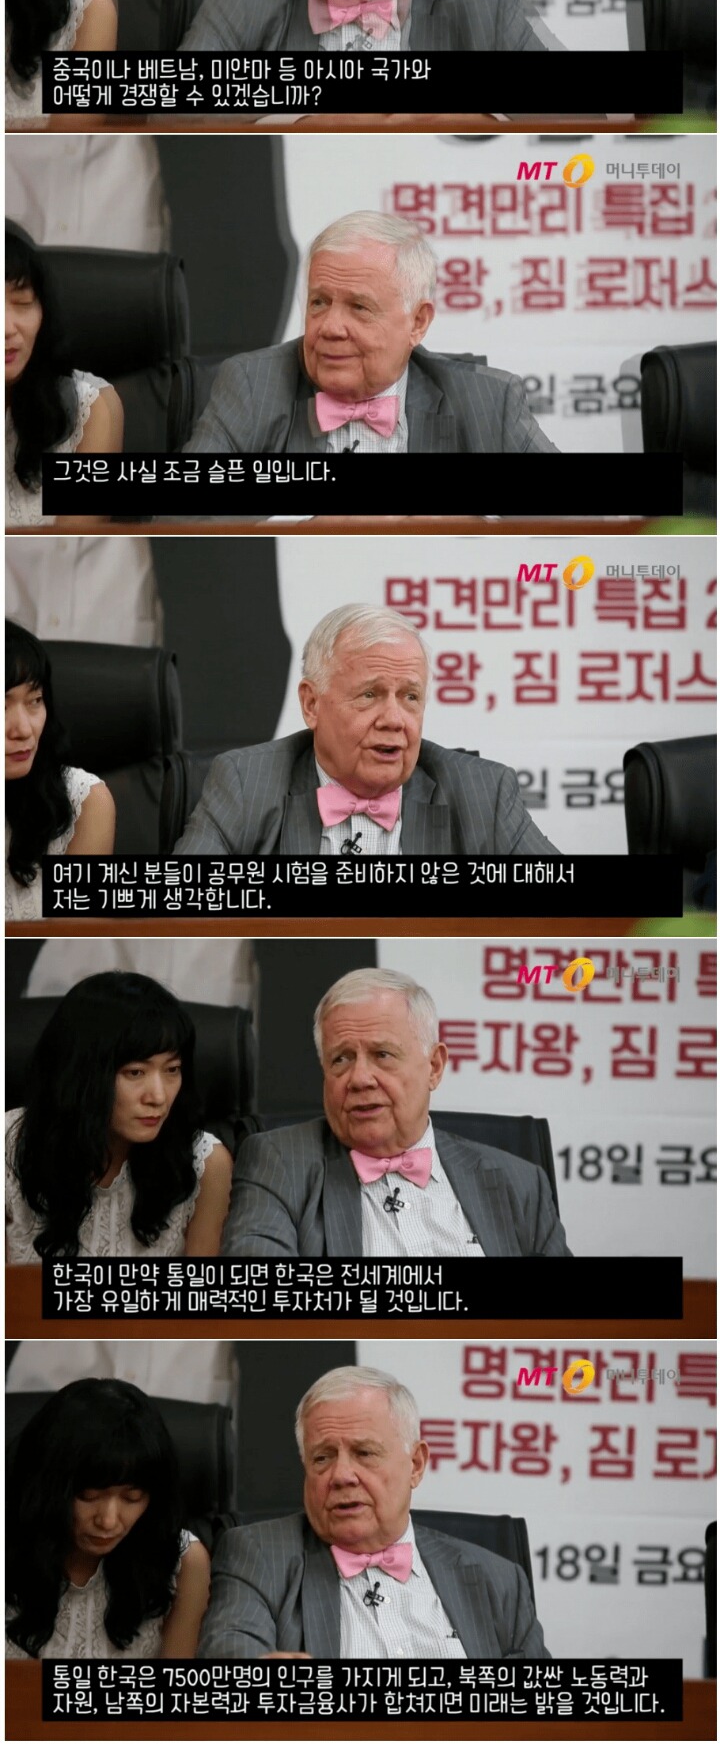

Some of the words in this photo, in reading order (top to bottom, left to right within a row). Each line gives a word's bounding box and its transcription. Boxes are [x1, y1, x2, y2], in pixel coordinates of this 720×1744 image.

[385, 577, 575, 631] 명견만리
[594, 577, 688, 631] 특집
[514, 652, 559, 705] 짐
[482, 945, 678, 1004] 명견만리
[611, 1024, 657, 1079] 짐
[558, 1142, 643, 1185] 18일
[462, 1345, 657, 1404] 명견만리
[588, 1425, 636, 1480] 짐
[535, 1544, 620, 1585] 18일
